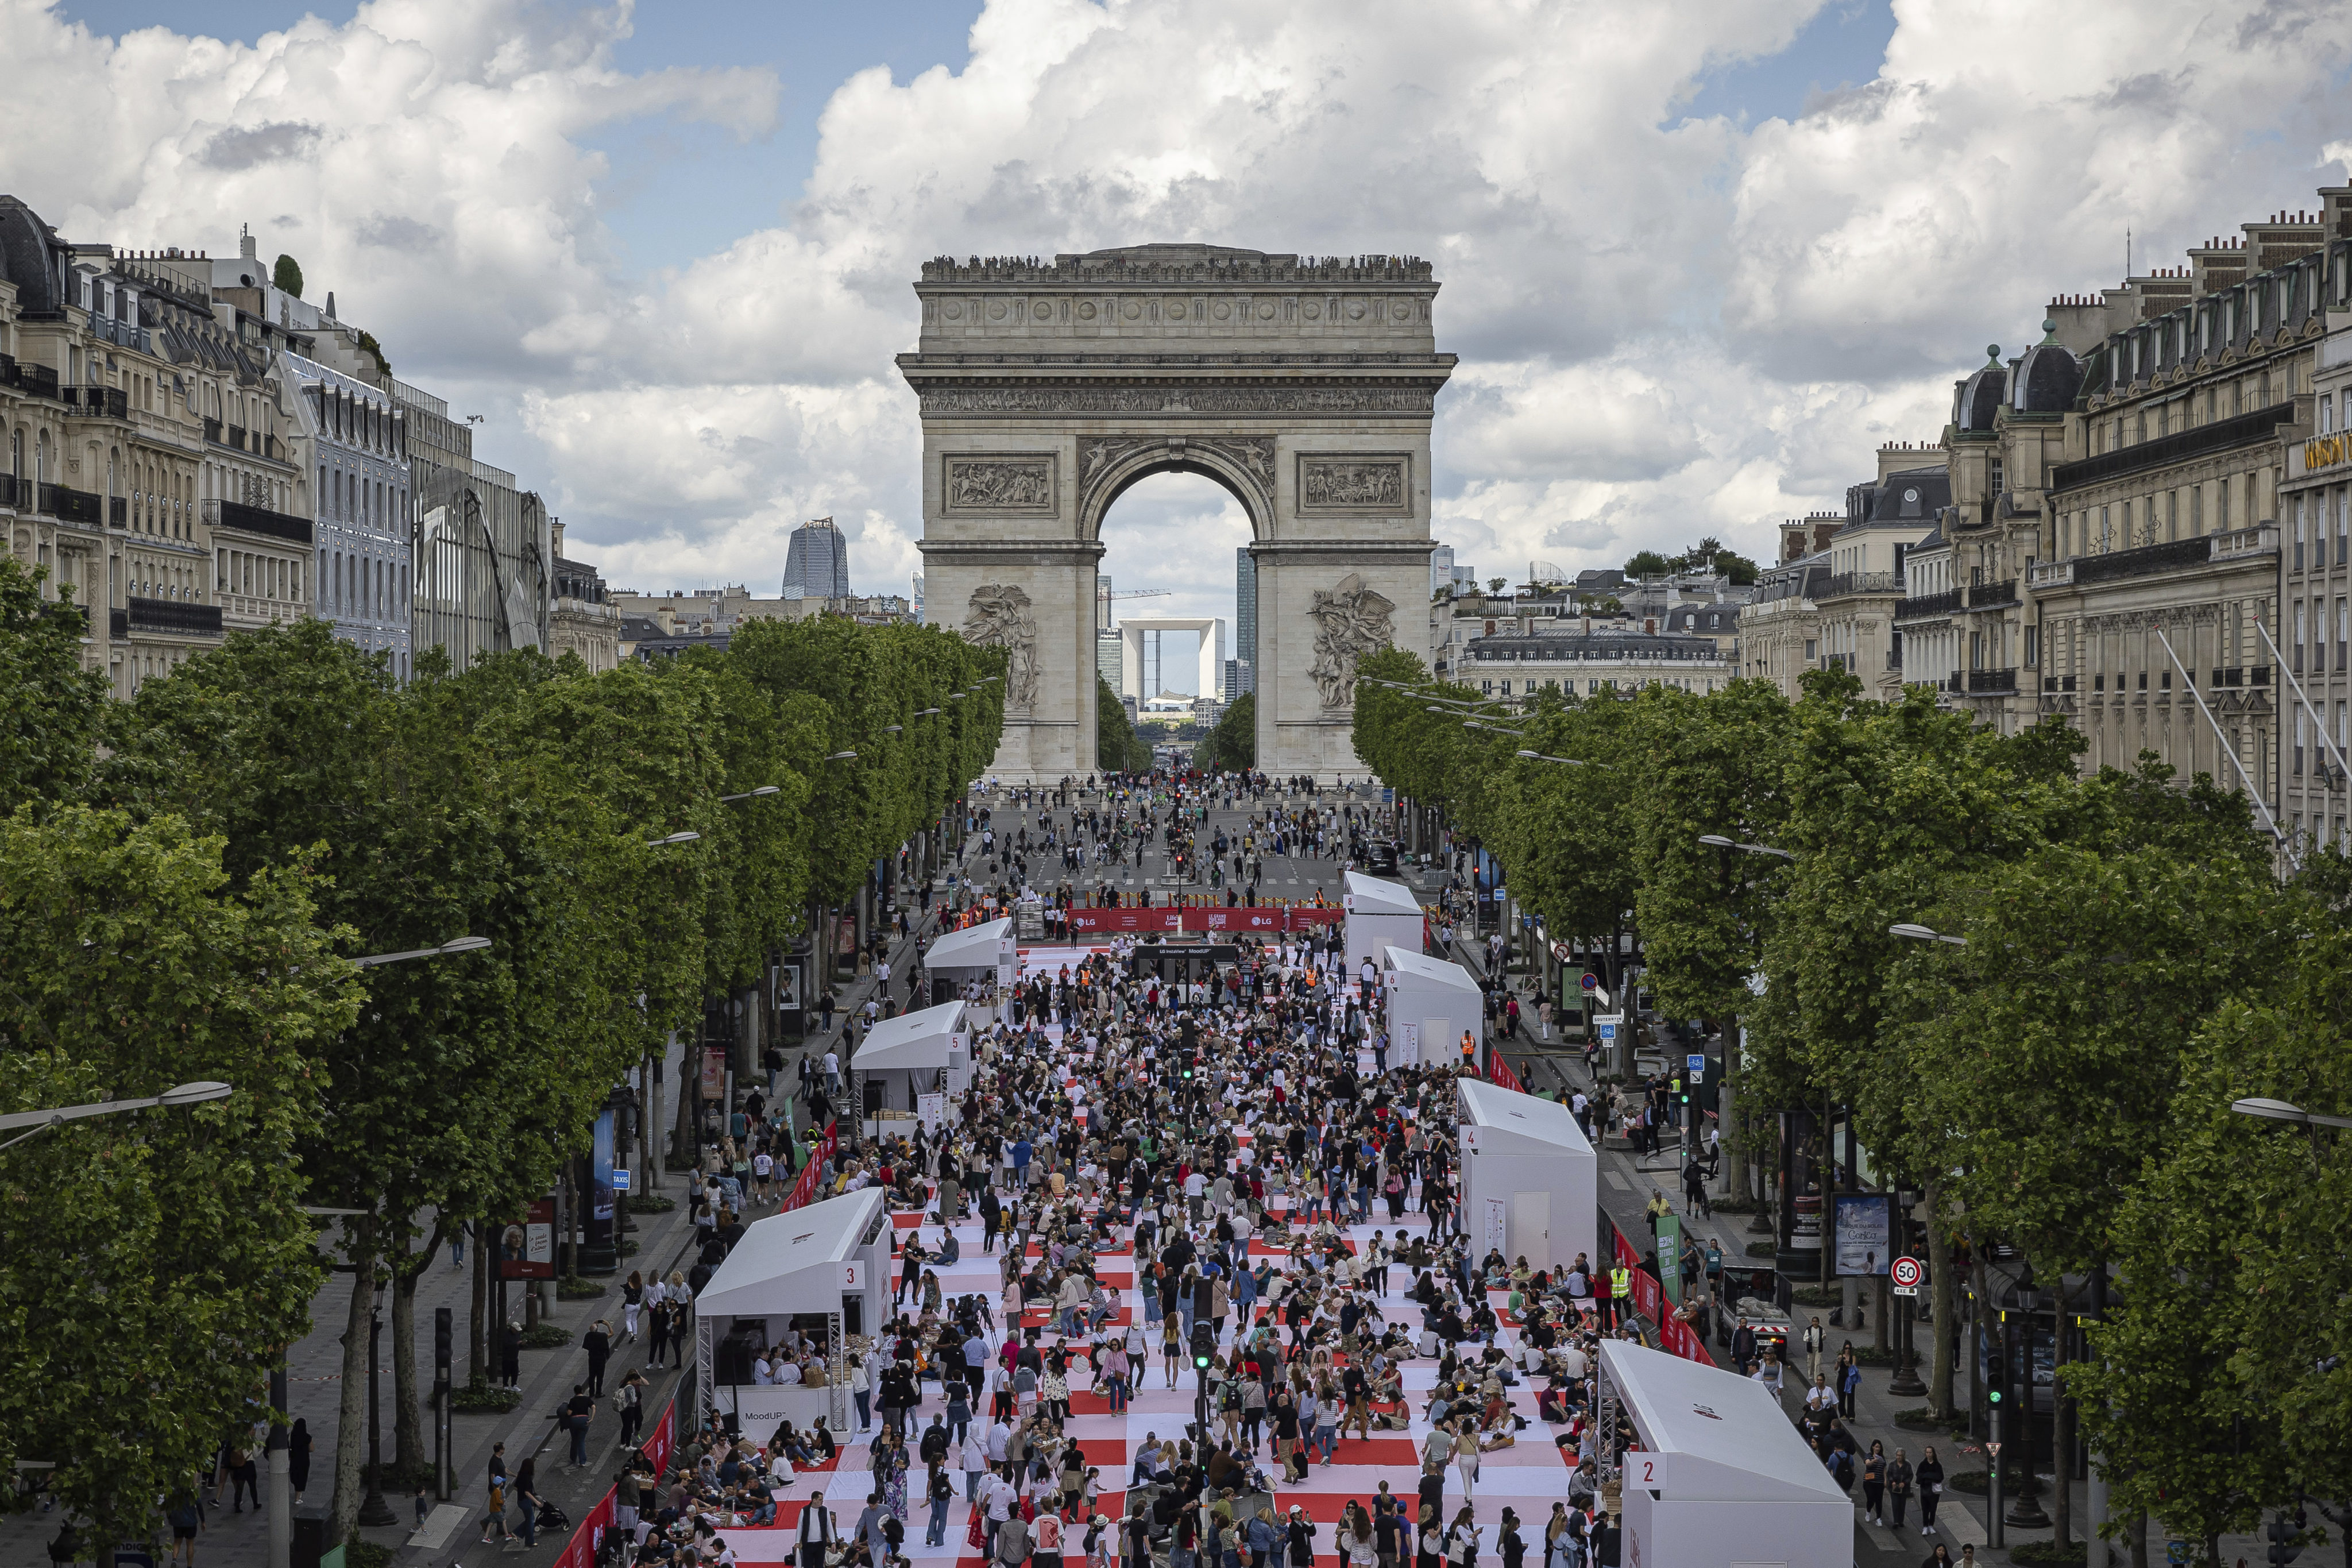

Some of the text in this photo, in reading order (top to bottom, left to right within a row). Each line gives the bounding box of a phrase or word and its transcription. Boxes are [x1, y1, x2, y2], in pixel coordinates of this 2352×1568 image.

[1348, 898, 1351, 906] 8
[1002, 942, 1006, 951] 7
[1390, 975, 1395, 984] 6
[953, 1037, 957, 1048] 5
[1468, 1131, 1474, 1144] 4
[847, 1268, 854, 1284] 3
[1898, 1266, 1915, 1279] 50
[1644, 1462, 1653, 1482] 2
